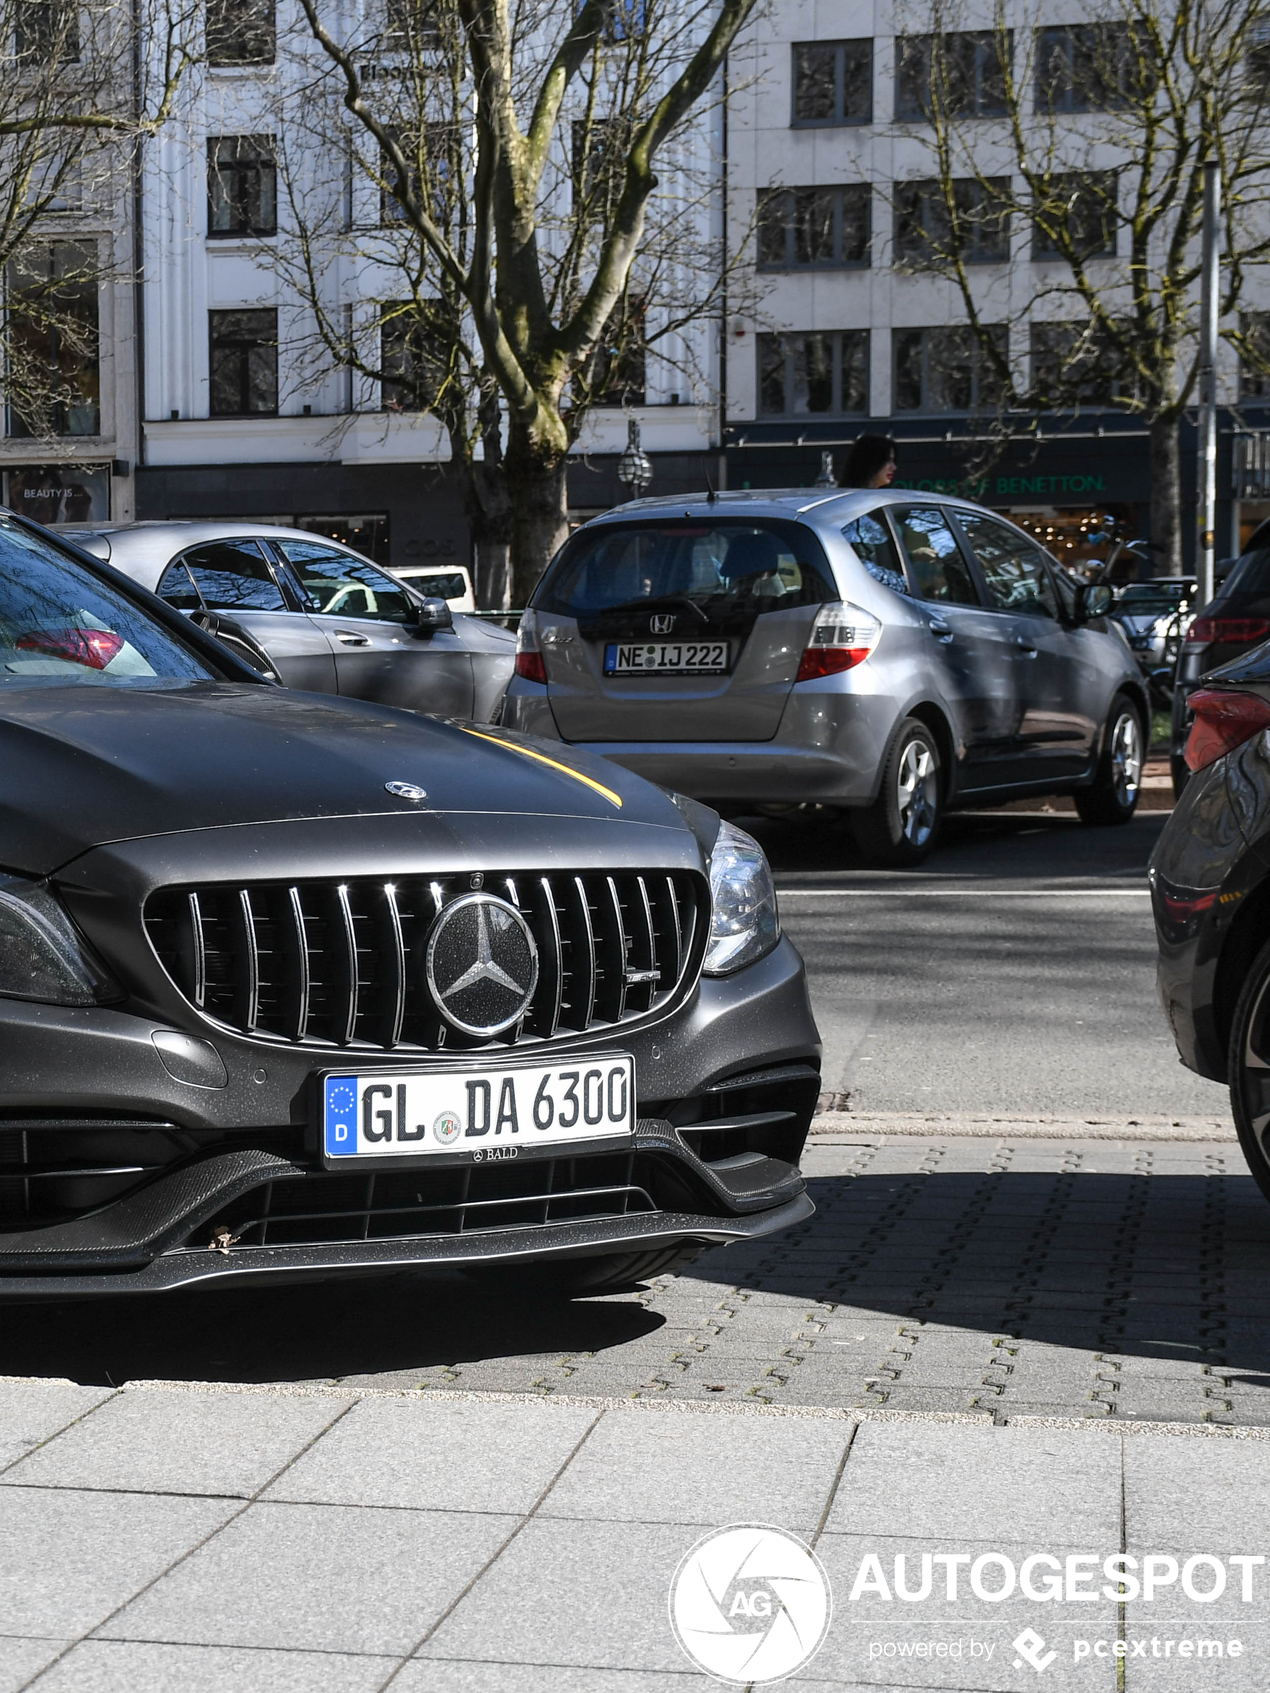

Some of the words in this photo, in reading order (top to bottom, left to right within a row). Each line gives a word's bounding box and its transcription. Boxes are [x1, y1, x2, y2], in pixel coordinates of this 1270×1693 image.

[24, 489, 62, 498] BEAUTY
[405, 540, 456, 558] COS
[618, 647, 643, 668] NE
[657, 646, 680, 667] IJ
[685, 645, 723, 667] 222
[335, 1123, 348, 1141] D
[363, 1083, 425, 1142] GL
[465, 1077, 519, 1137] DA
[533, 1067, 627, 1131] 6300
[486, 1147, 518, 1160] BALD
